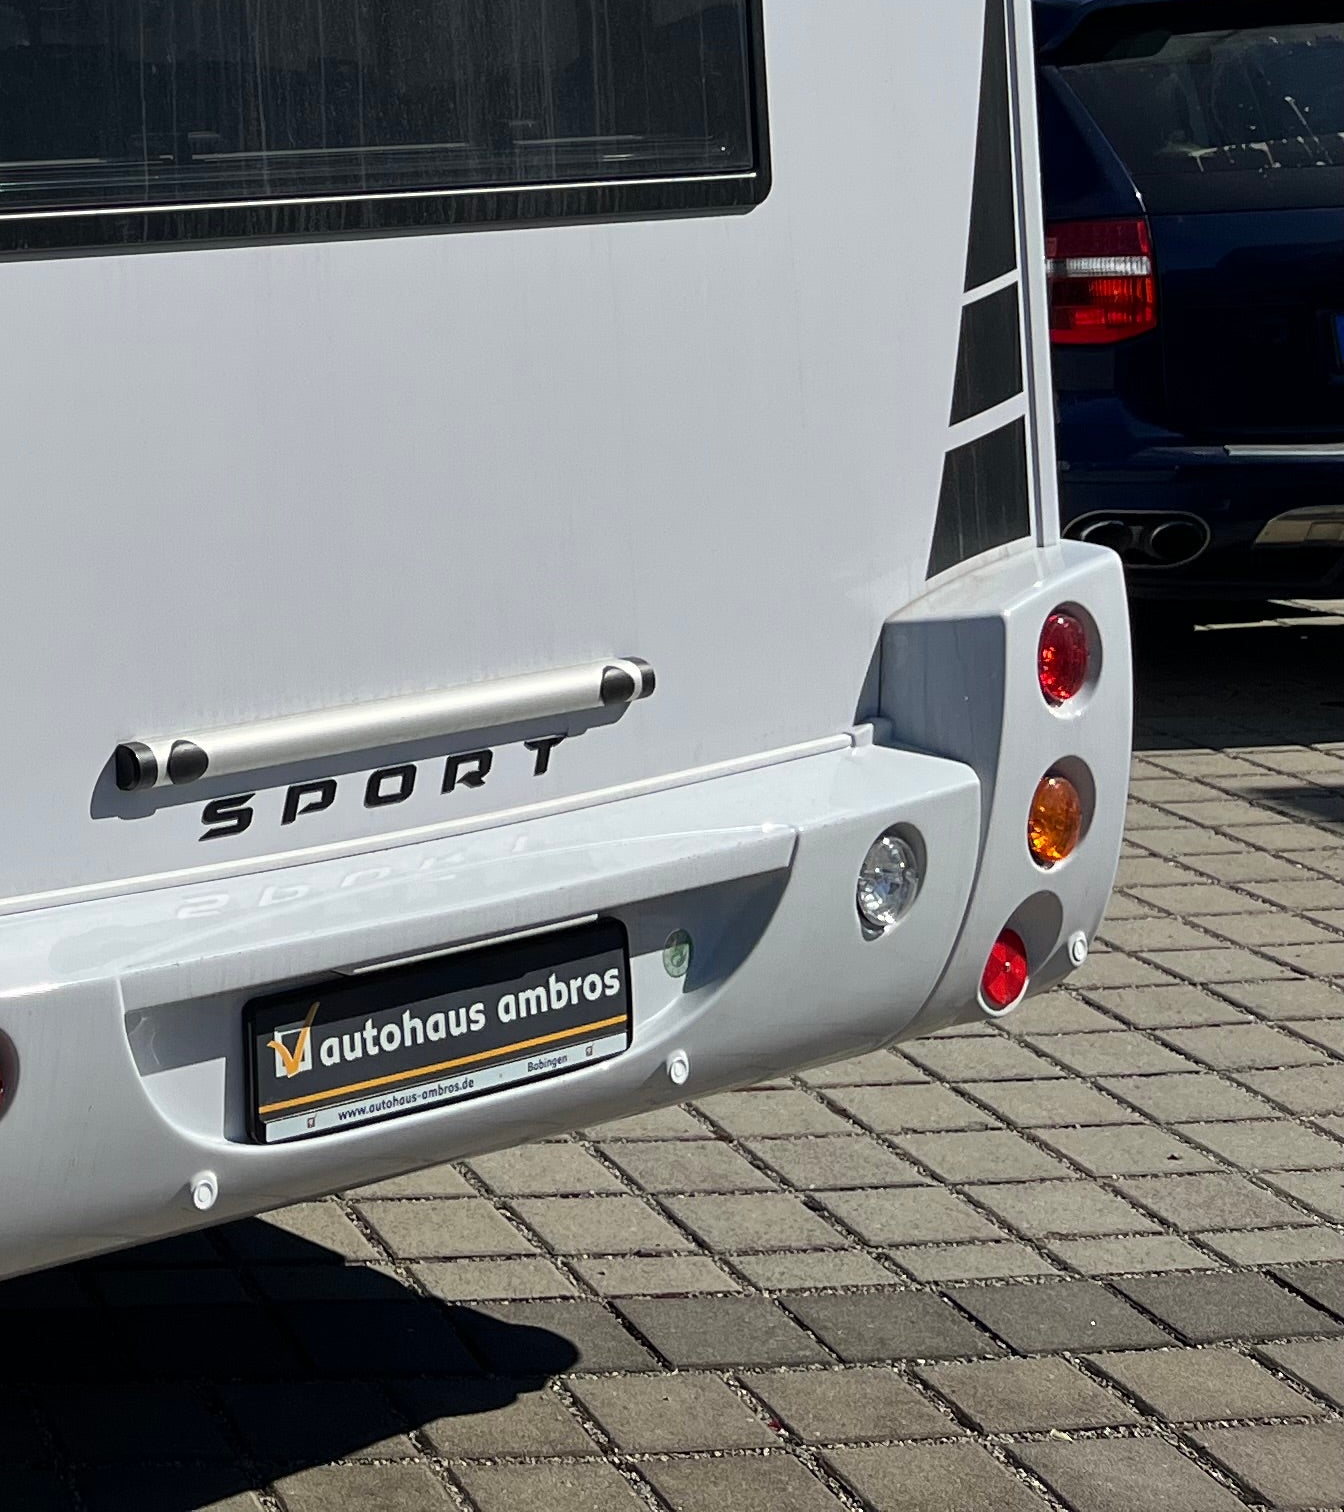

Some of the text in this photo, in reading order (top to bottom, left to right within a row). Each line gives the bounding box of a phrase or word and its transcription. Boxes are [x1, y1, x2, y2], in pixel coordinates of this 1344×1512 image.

[198, 735, 568, 842] SPORT
[319, 966, 621, 1067] autohaus ambros
[337, 1076, 475, 1121] www.autohaus-ambros.de
